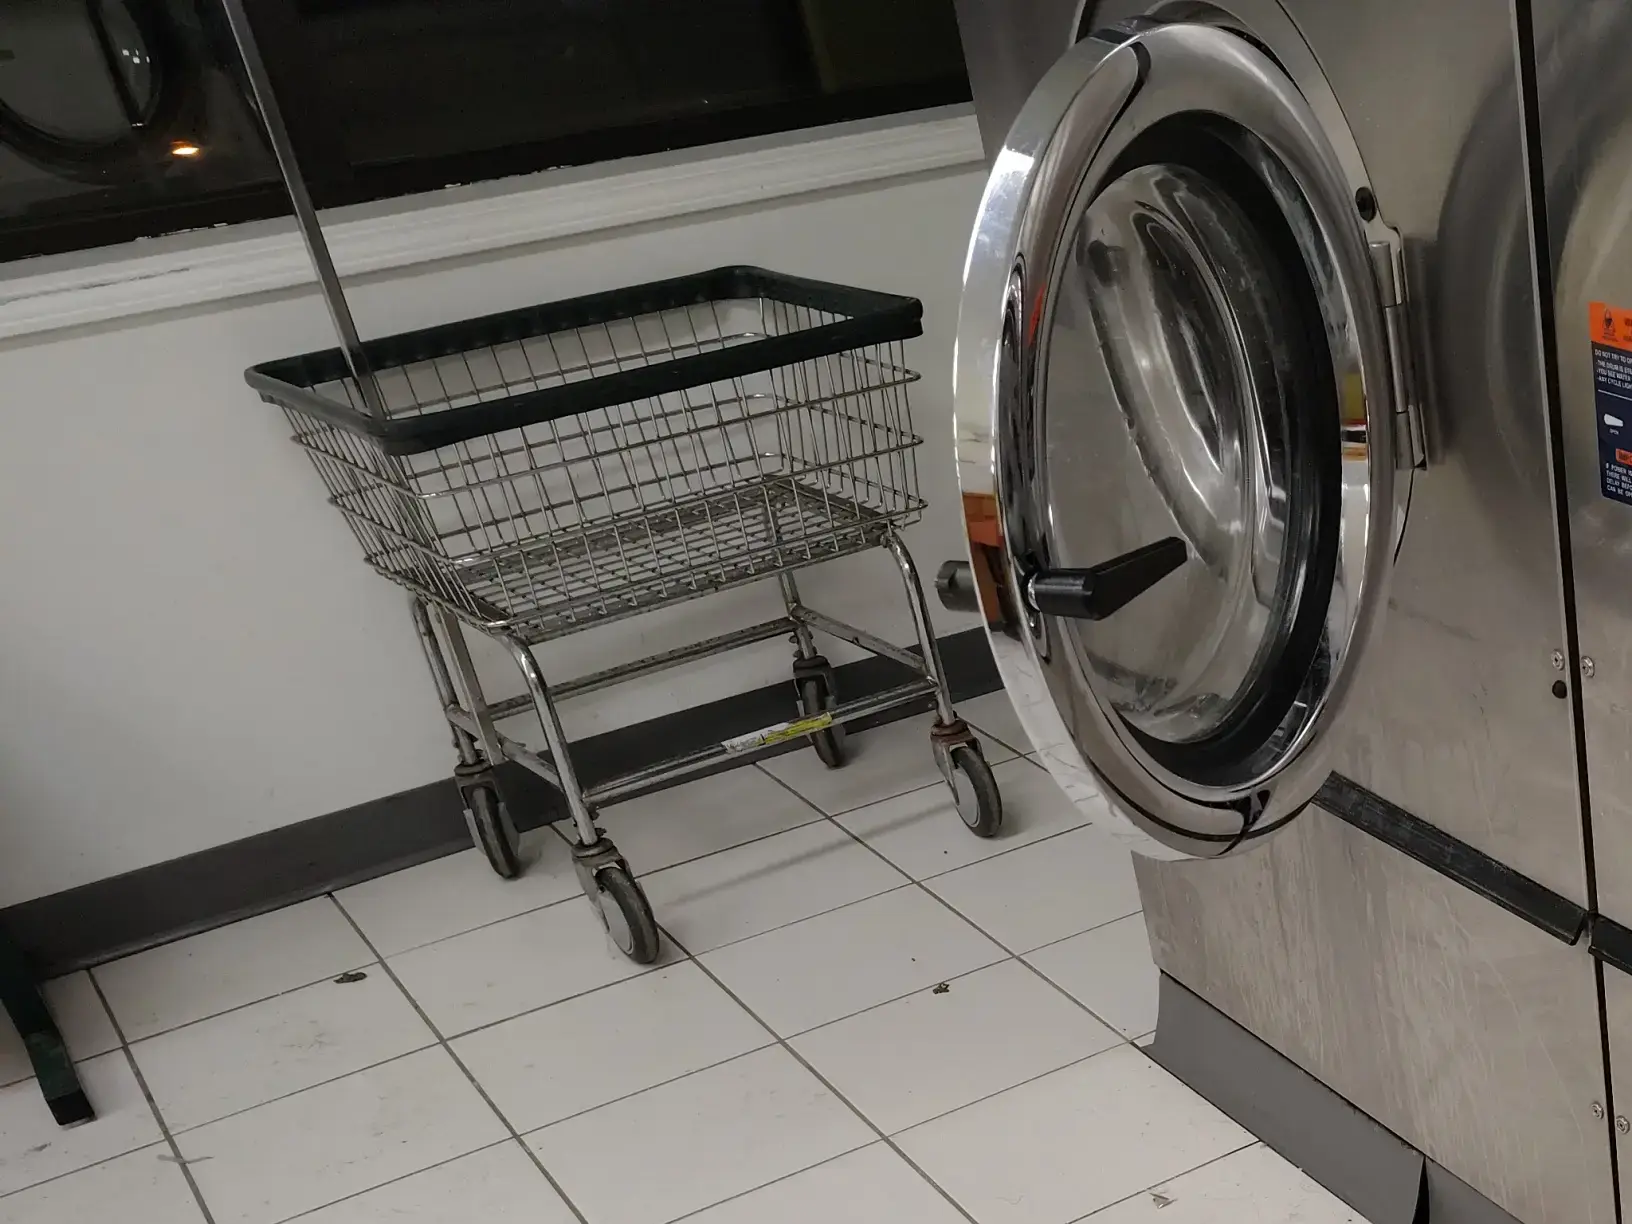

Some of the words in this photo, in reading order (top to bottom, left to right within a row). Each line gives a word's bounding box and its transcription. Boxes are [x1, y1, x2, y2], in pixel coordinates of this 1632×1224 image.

[1611, 464, 1626, 474] POWER
[1606, 470, 1620, 480] THERE
[1621, 475, 1631, 483] WILL
[1606, 477, 1620, 487] DELAY
